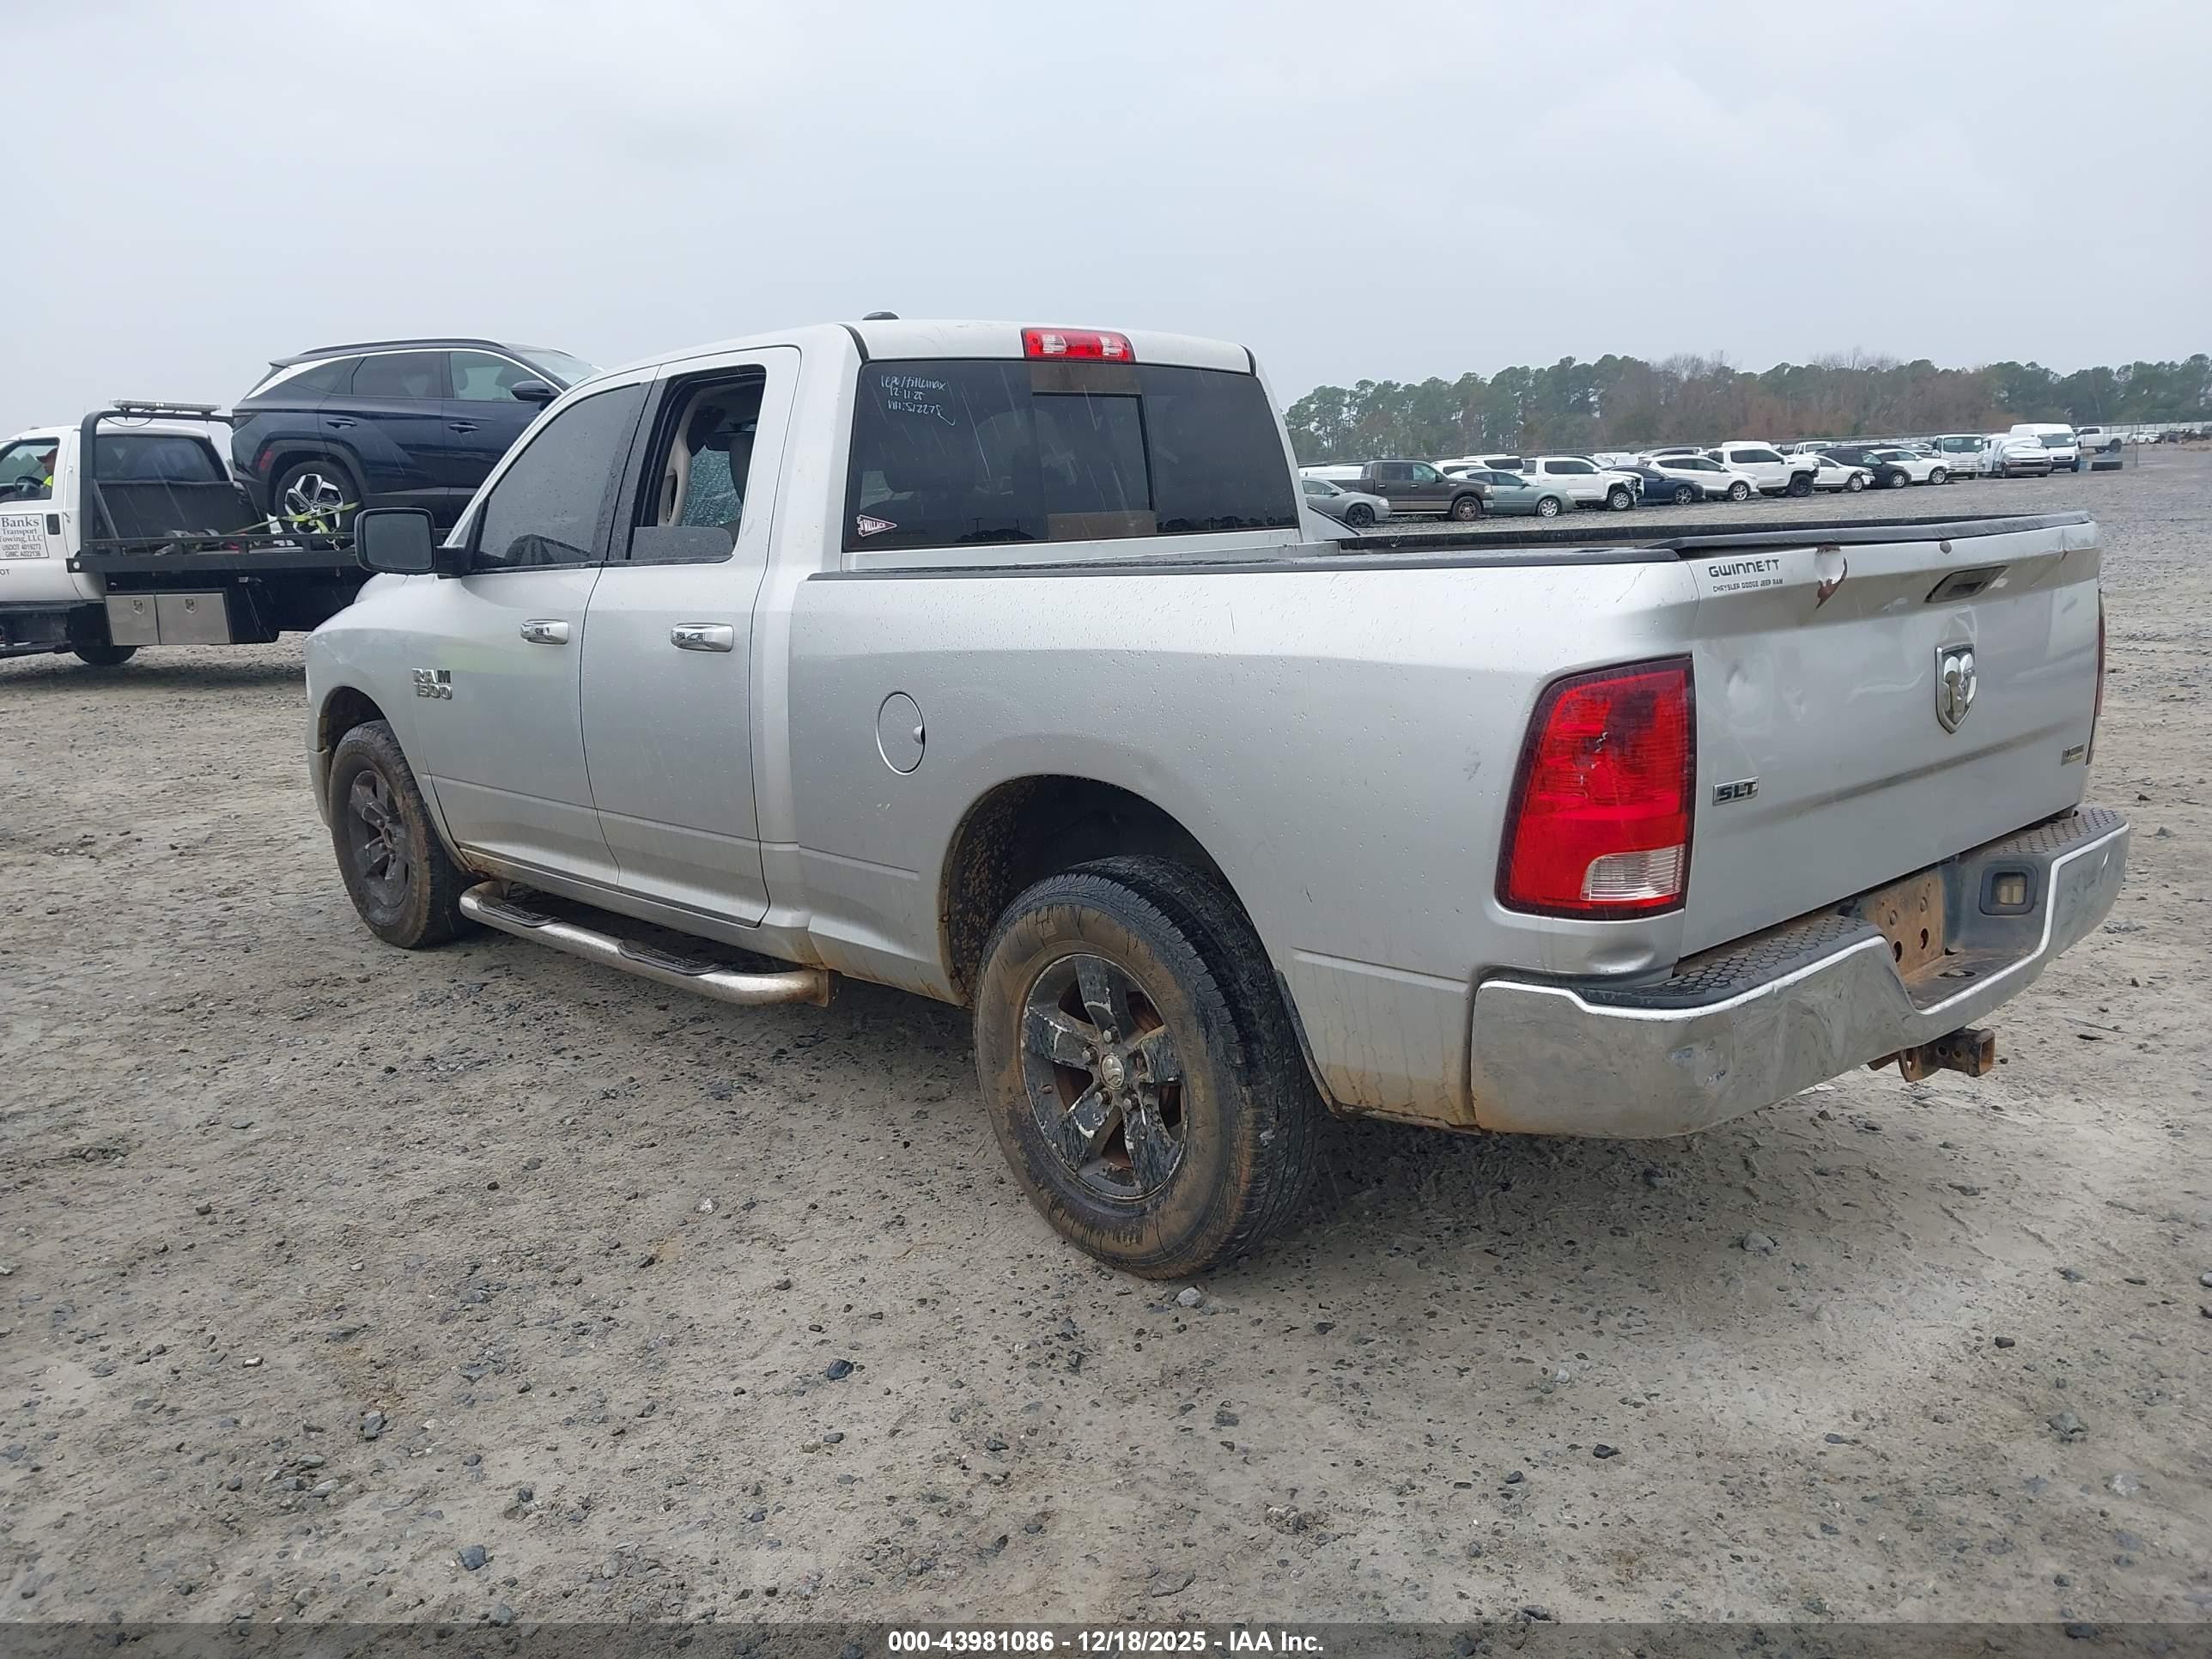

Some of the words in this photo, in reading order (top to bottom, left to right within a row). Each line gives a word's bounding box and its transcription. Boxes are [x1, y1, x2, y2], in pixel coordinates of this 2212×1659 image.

[2, 516, 40, 527] Banks
[1709, 559, 1779, 577] GWINNETT
[1713, 583, 1740, 592] CHRYSLER
[412, 667, 452, 684] RAM
[1717, 781, 1756, 800] SLT
